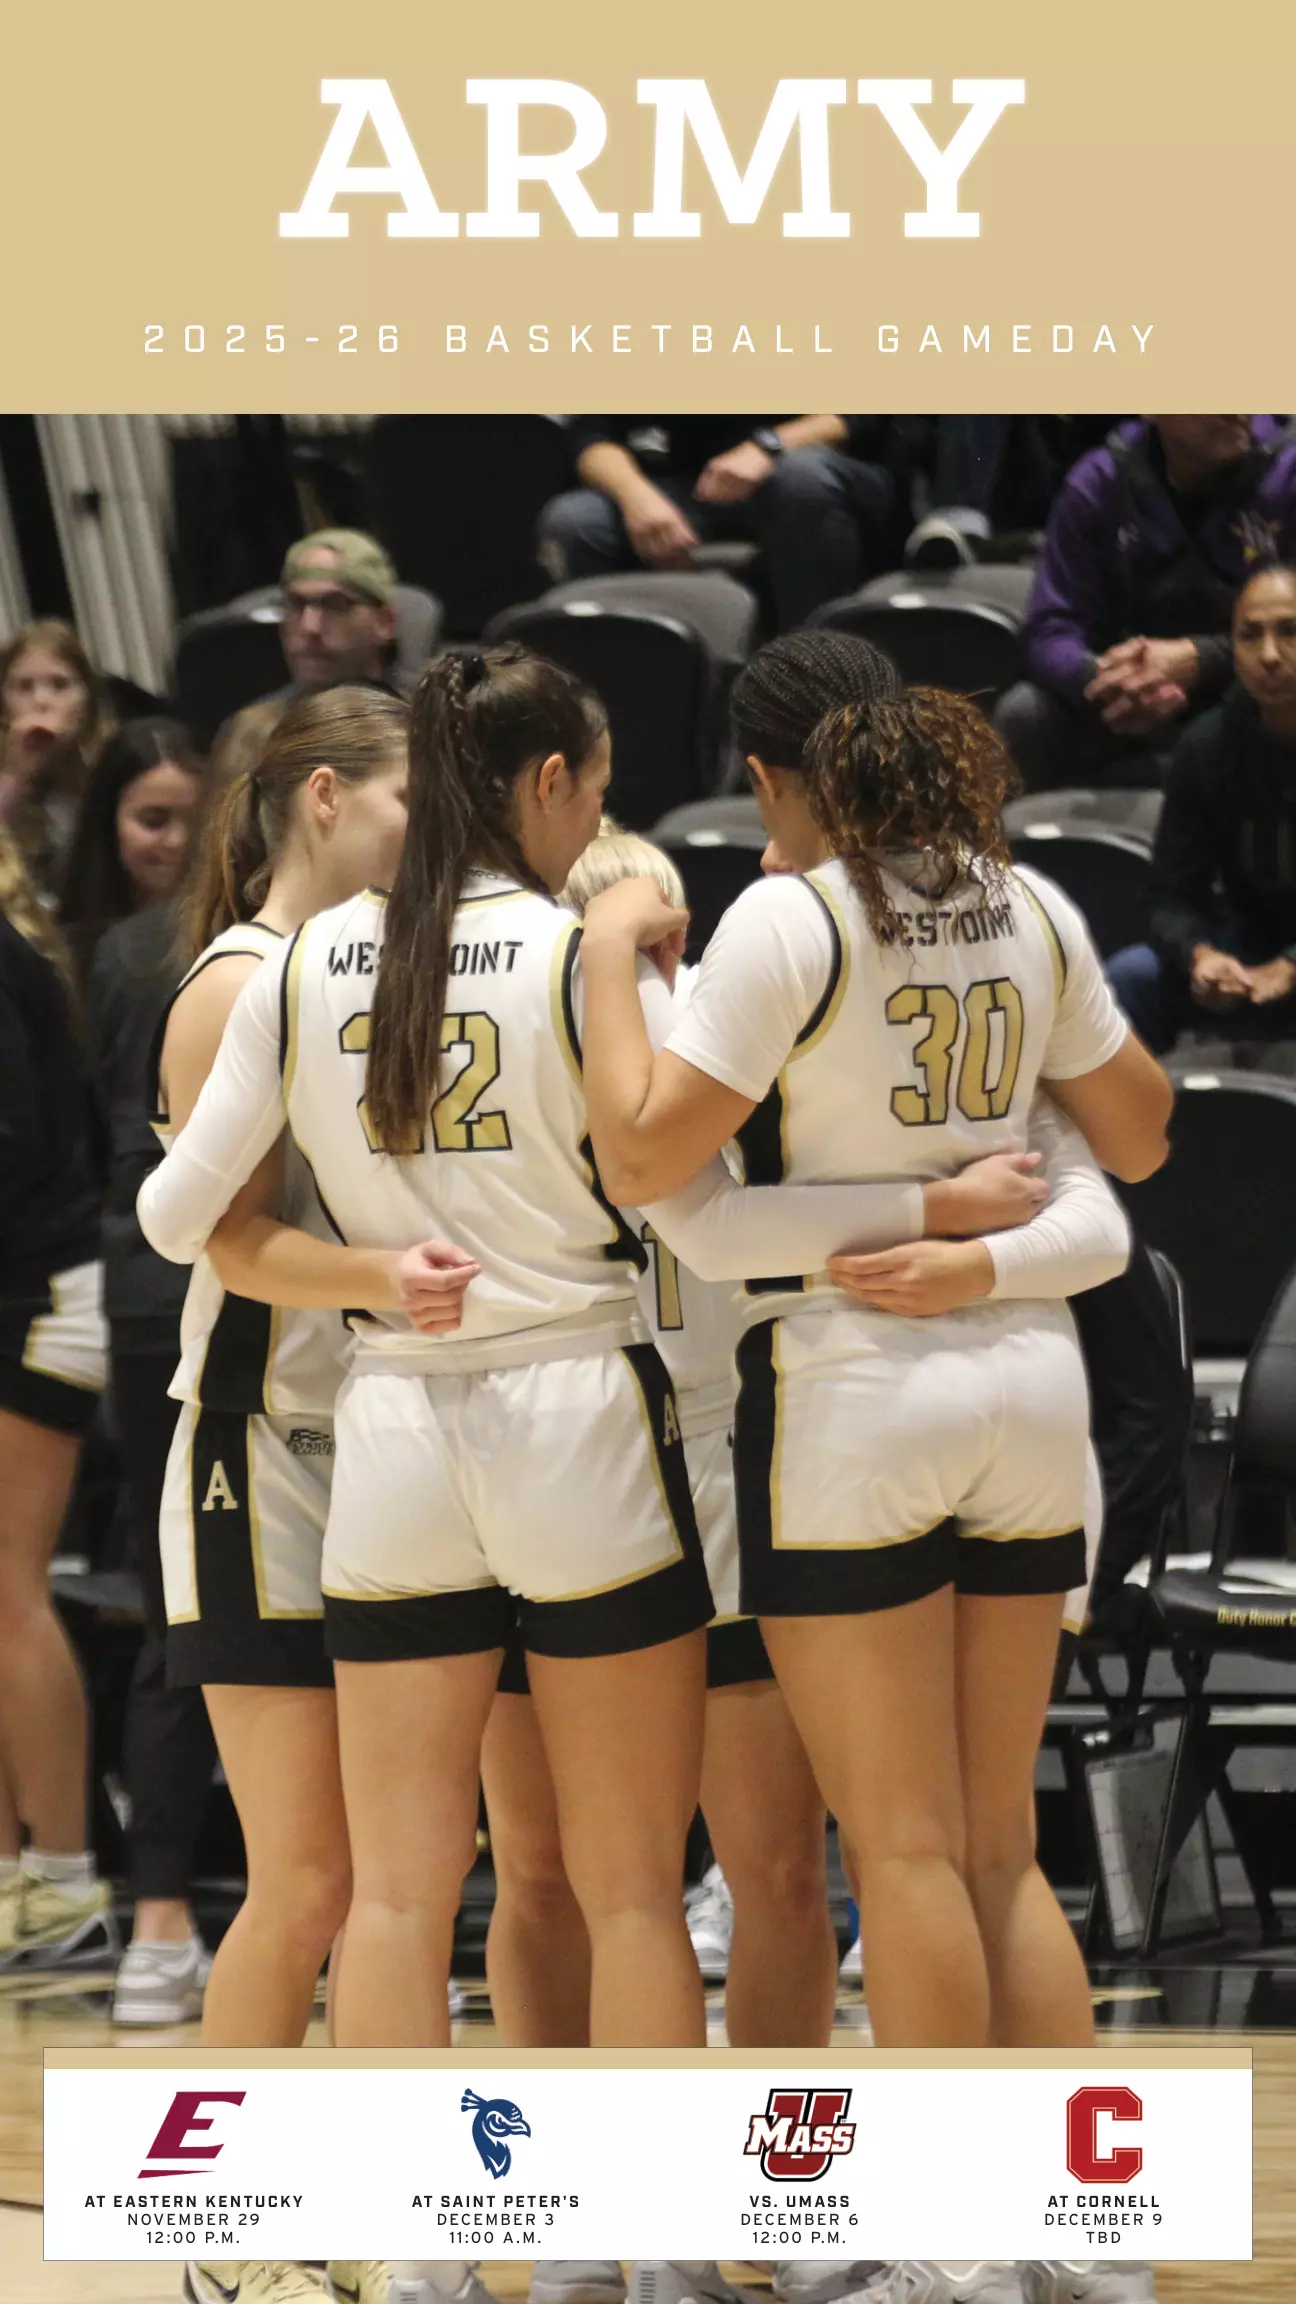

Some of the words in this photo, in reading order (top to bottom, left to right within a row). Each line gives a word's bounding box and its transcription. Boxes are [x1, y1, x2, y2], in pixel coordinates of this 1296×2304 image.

[328, 941, 387, 977] WE
[449, 941, 523, 977] OINT
[885, 977, 1024, 1127] 30
[202, 1460, 238, 1511] A
[1217, 1605, 1246, 1627] Duty
[1249, 1607, 1286, 1627] Honor
